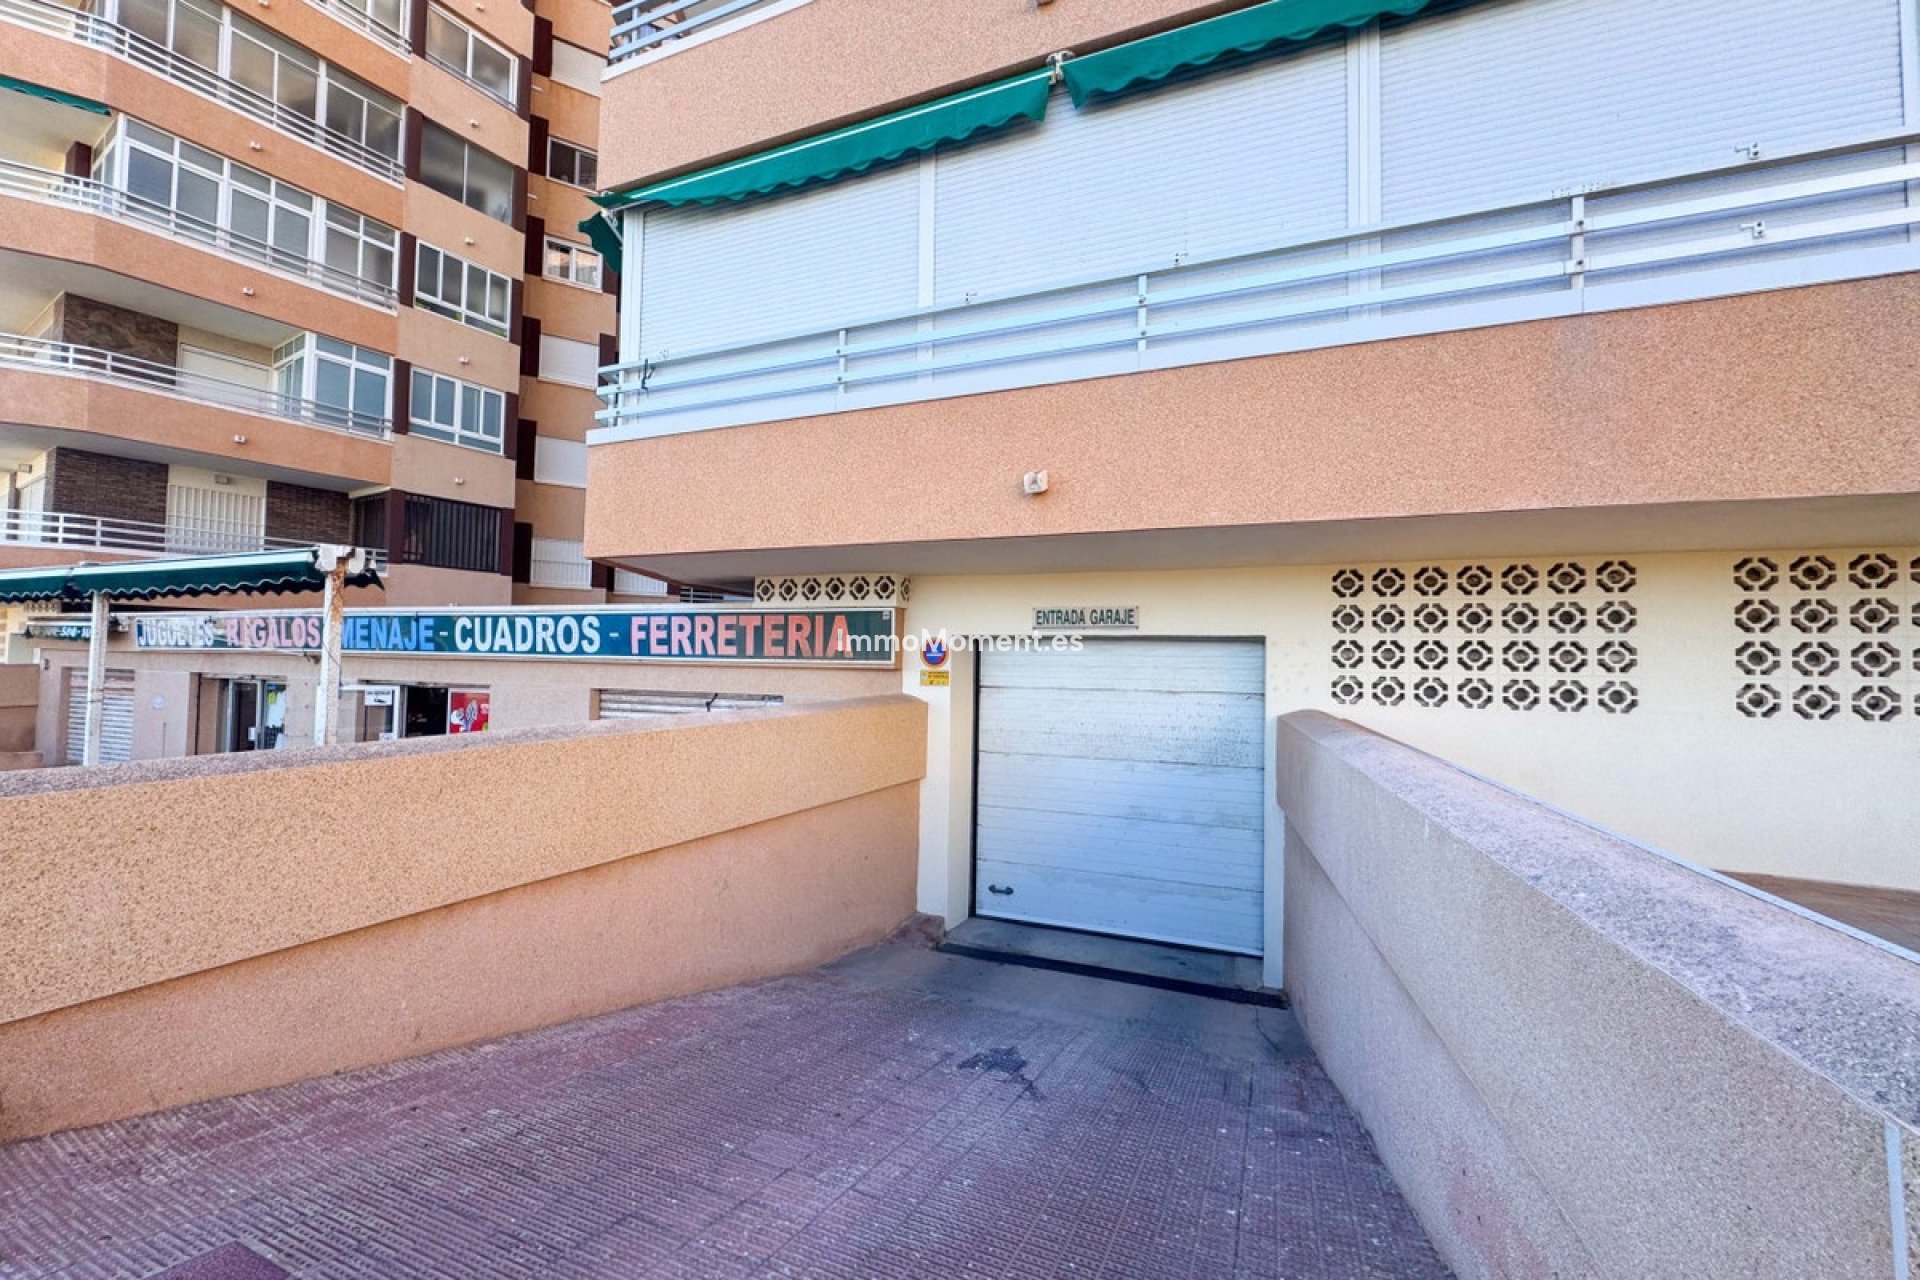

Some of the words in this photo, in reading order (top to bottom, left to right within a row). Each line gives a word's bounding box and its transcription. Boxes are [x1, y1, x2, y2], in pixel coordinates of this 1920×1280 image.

[1036, 609, 1086, 625] ENTRADA
[1090, 609, 1135, 625] GARAJE
[138, 617, 214, 646] JUGUETES
[226, 616, 321, 647] REGALOS
[455, 616, 600, 653] CUADROS
[631, 614, 854, 659] FERRETERIA
